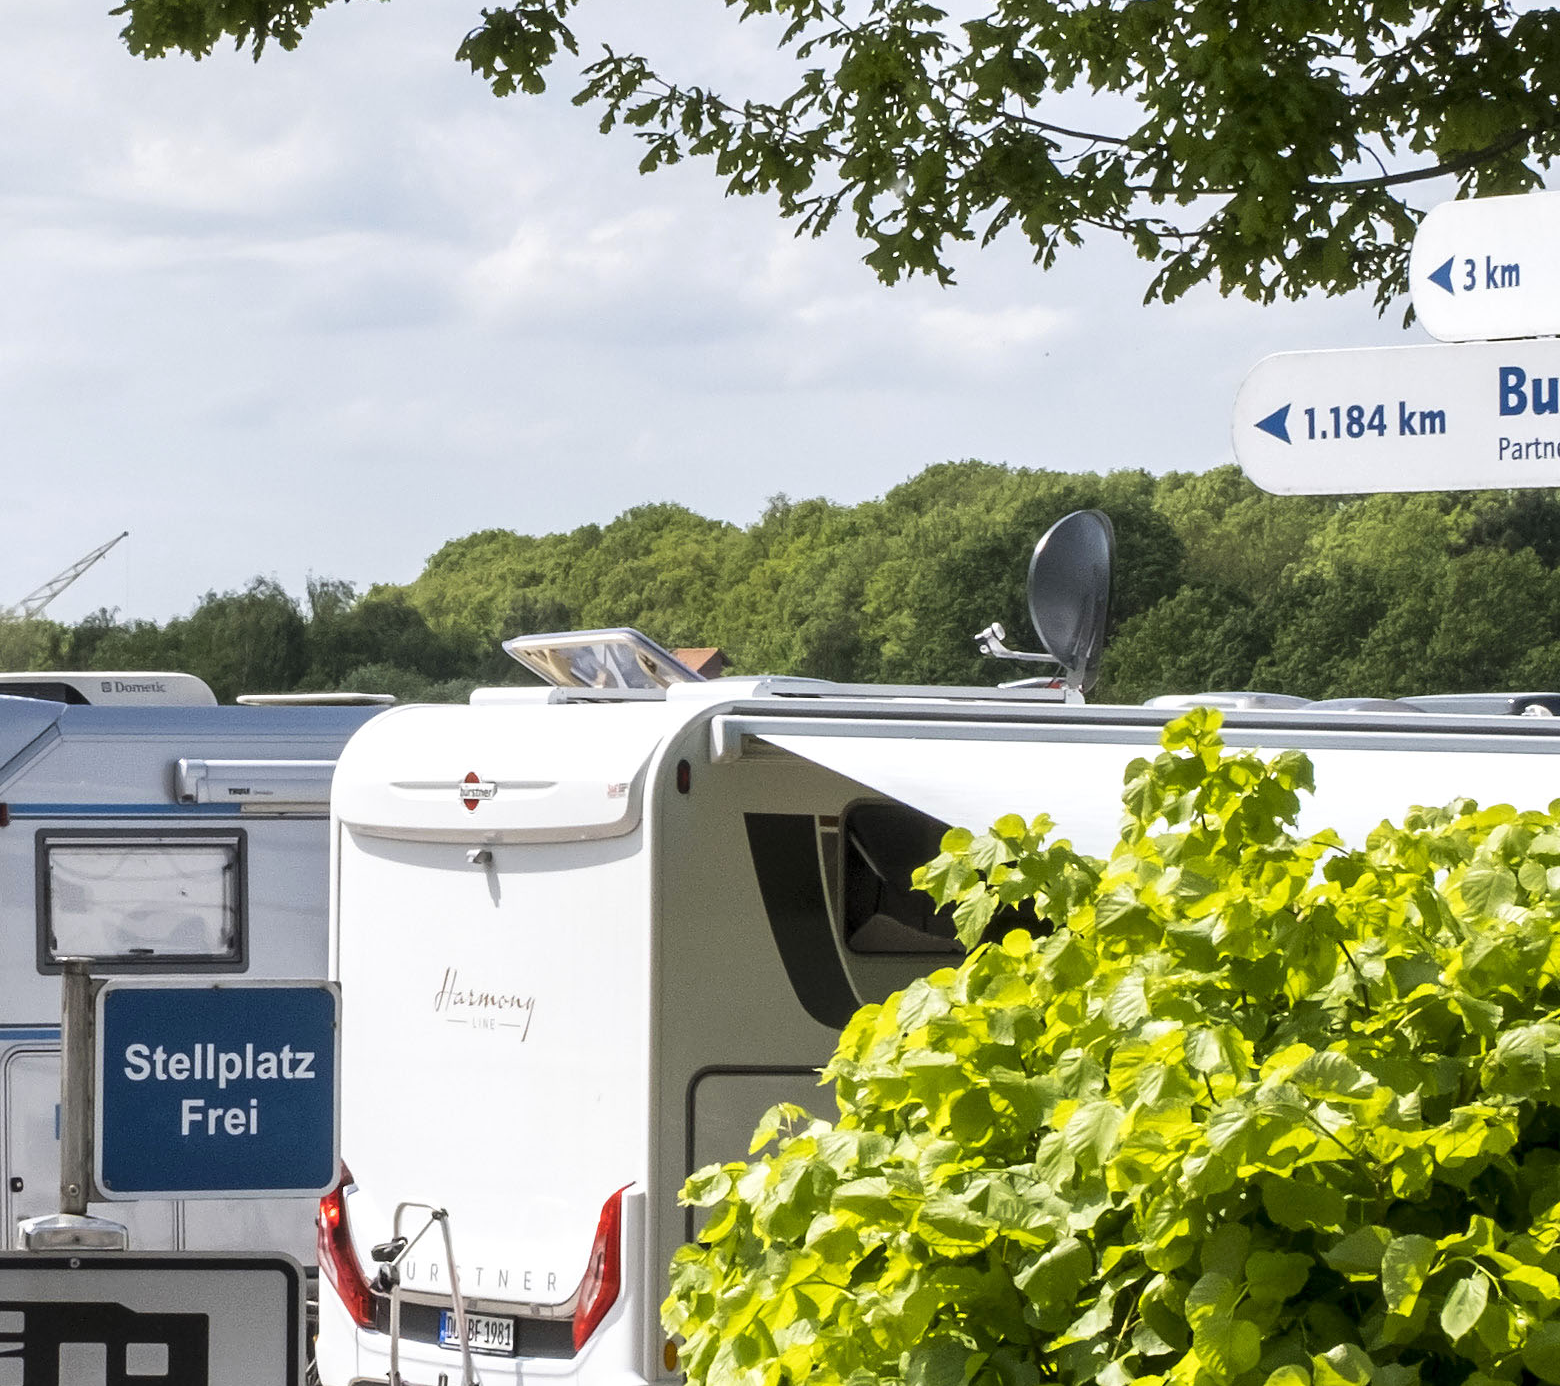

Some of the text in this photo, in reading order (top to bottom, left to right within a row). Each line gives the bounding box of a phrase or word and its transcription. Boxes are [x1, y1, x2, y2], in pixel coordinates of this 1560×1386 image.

[1462, 258, 1479, 292] 3
[1485, 255, 1521, 289] km
[1304, 403, 1386, 440] 1.184
[1399, 400, 1447, 436] km
[115, 681, 167, 694] Dometic
[434, 966, 536, 1043] Harmony
[472, 1016, 496, 1030] LINE
[124, 1043, 316, 1089] Stellplatz
[181, 1098, 259, 1135] Frei
[396, 1256, 557, 1291] ÜRTNER
[484, 1322, 511, 1346] 1981
